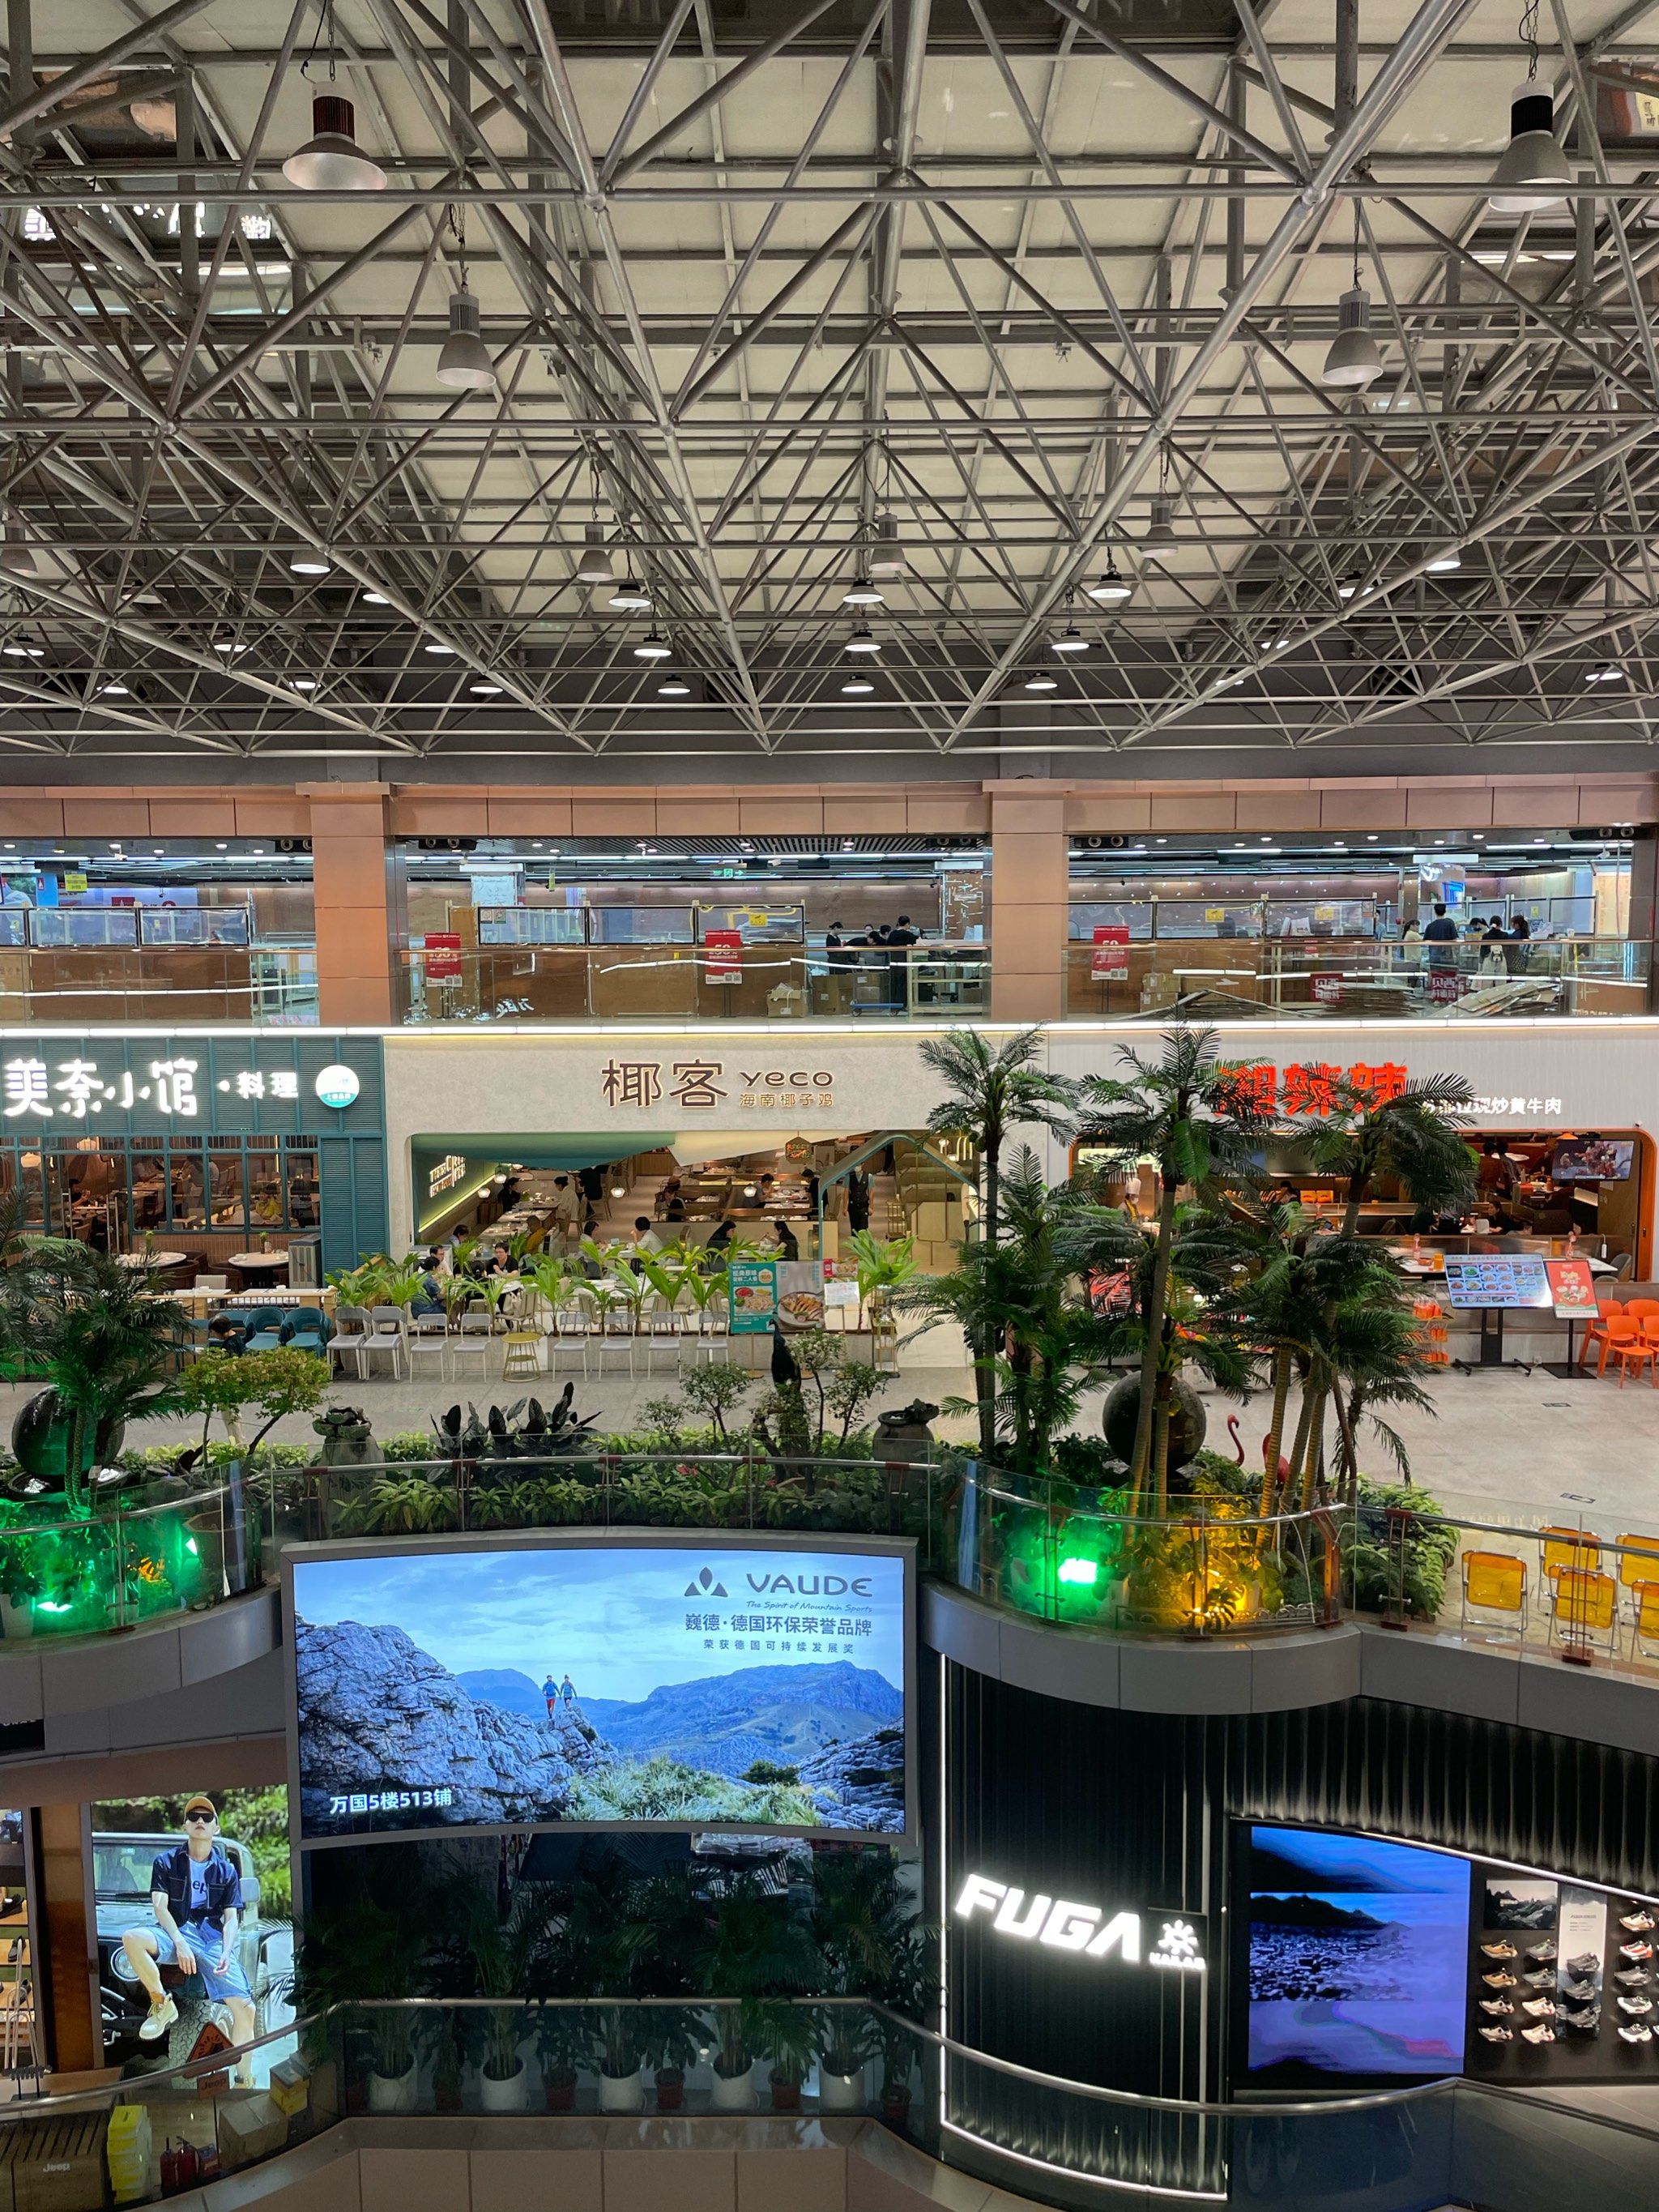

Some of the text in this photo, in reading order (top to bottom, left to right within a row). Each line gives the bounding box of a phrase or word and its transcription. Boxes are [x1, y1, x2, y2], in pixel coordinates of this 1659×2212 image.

[3, 1058, 198, 1118] 美奈小馆
[601, 1058, 729, 1108] 椰客
[739, 1070, 834, 1087] yeco
[739, 1092, 834, 1108] 海南椰子鸡
[746, 1574, 872, 1597] VAUDE
[746, 1600, 761, 1608] The
[763, 1601, 787, 1610] Spirit
[800, 1602, 842, 1612] Mountain
[845, 1604, 872, 1613] Sports
[703, 1639, 854, 1654] 荣获德国可持续发展奖
[330, 1788, 453, 1814] 万国5楼513铺
[954, 1873, 1141, 1962] FUGA
